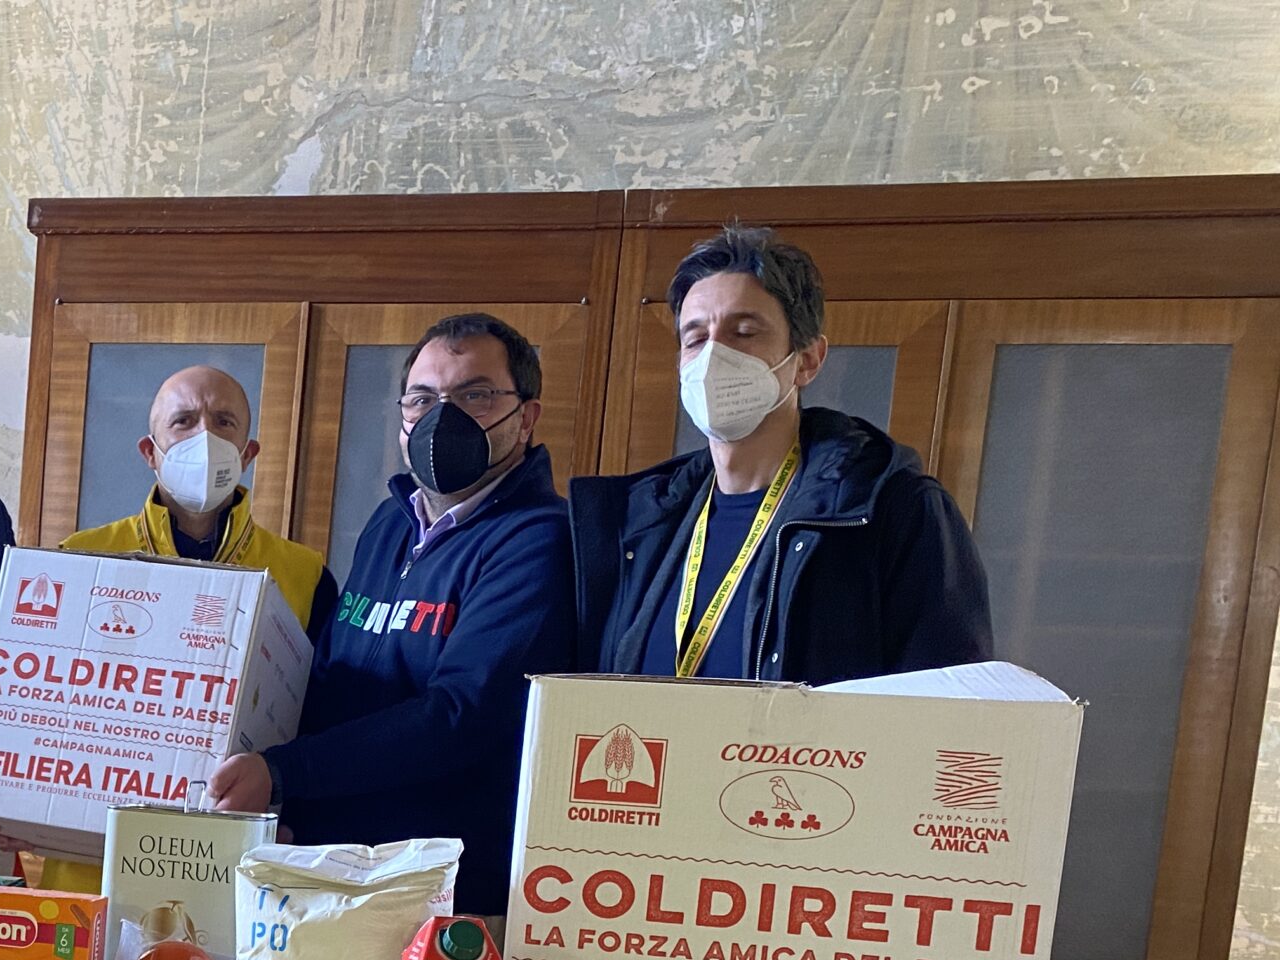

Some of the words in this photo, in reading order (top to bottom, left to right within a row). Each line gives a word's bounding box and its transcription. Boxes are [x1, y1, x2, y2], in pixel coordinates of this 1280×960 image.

[740, 519, 764, 560] COLDIRETTI
[90, 585, 162, 603] CODACONS
[705, 580, 732, 621] COLDIRETTI
[11, 616, 57, 630] COLDIRETTI
[179, 632, 226, 645] CAMPAGNA
[187, 641, 216, 650] AMICA
[7, 684, 65, 704] FORZA
[70, 693, 127, 712] AMICA
[133, 701, 167, 717] DEL
[172, 706, 232, 726] PAESE
[21, 712, 70, 729] DEBOLI
[73, 720, 99, 733] NEL
[103, 724, 160, 741] NOSTRO
[164, 732, 214, 749] CUORE
[33, 736, 154, 762] #CAMPAGNAAMICA
[720, 743, 867, 769] CODACONS
[36, 785, 80, 798] PRODURRE
[101, 765, 190, 801] ITALIA
[567, 805, 661, 827] COLDIRETTI
[918, 813, 1008, 825] FONDAZIONE
[913, 823, 1010, 843] CAMPAGNA
[930, 838, 989, 854] AMICA
[139, 834, 214, 860] OLEUM
[120, 855, 231, 884] NOSTRUM
[523, 864, 1042, 956] COLDIRETTI
[59, 935, 68, 948] 6
[525, 923, 566, 948] LA
[577, 927, 694, 960] FORZA
